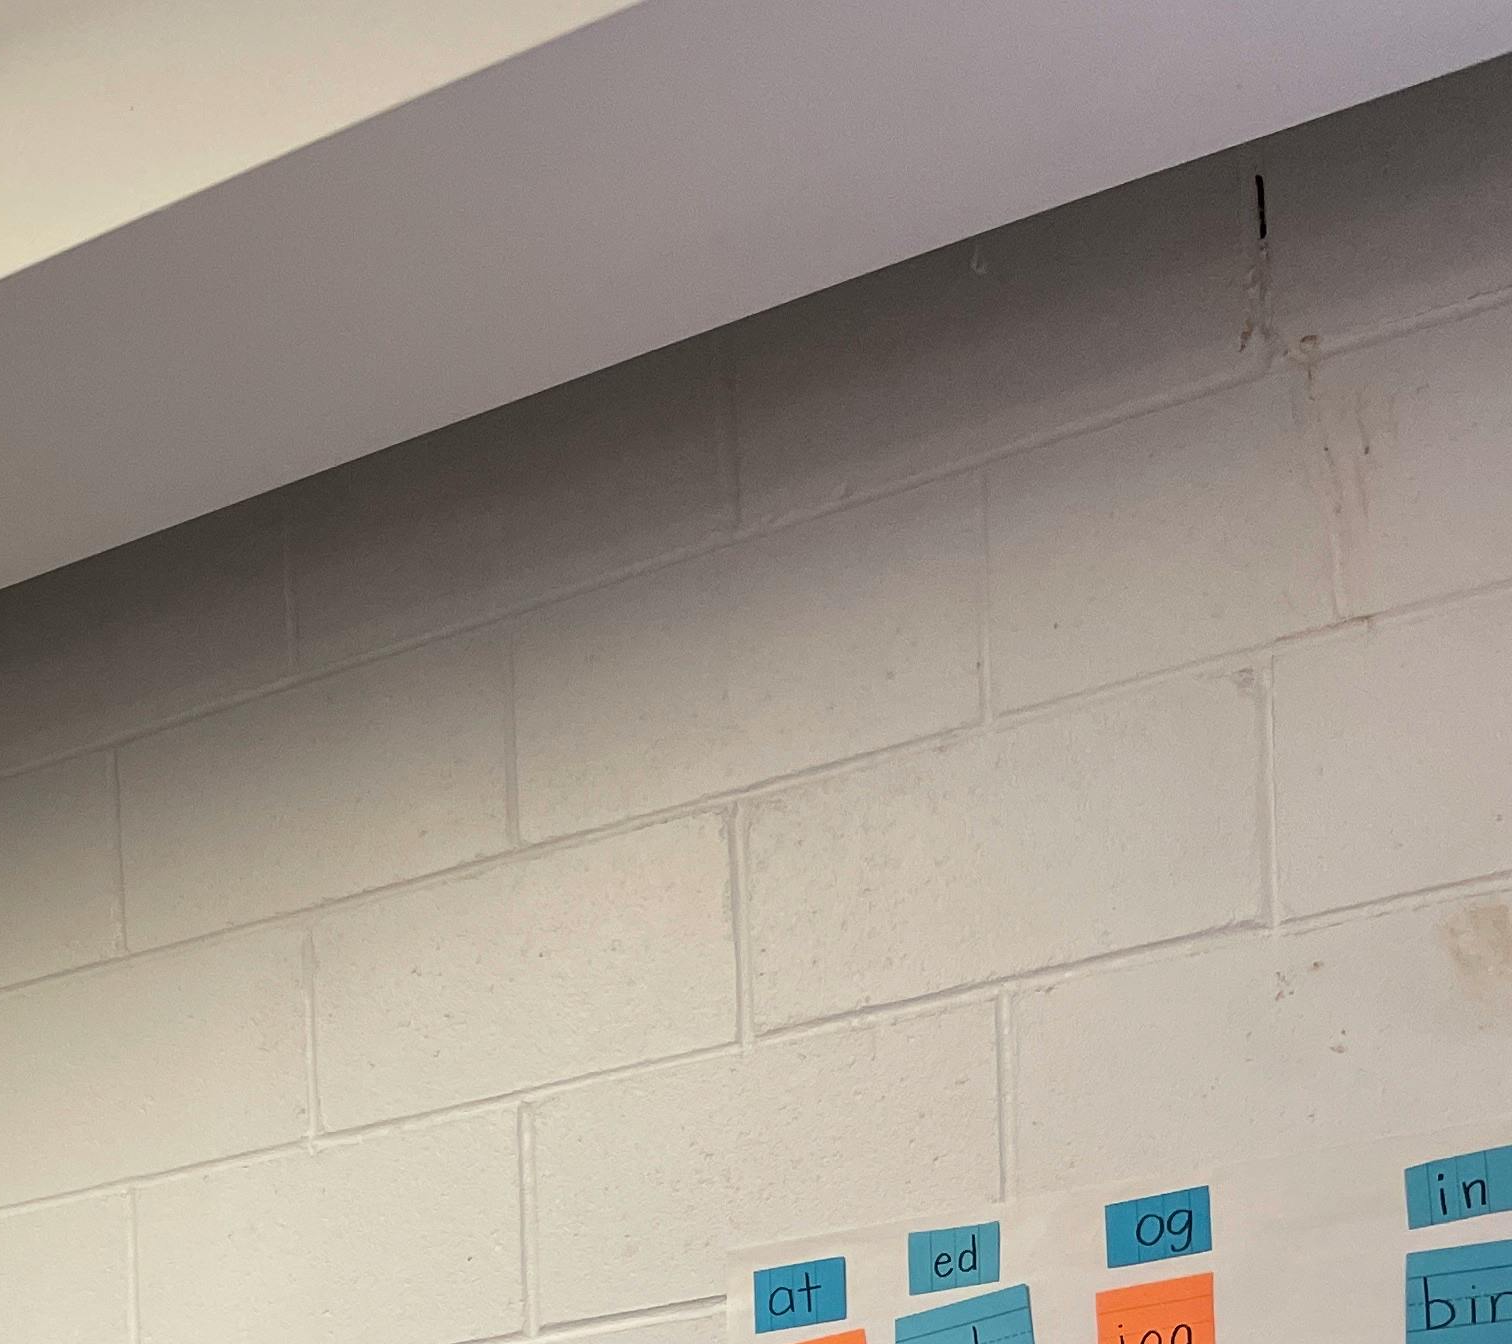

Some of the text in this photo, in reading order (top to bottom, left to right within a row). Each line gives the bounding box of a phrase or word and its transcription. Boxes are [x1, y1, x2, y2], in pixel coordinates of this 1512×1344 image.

[1437, 1172, 1487, 1216] in
[1135, 1208, 1193, 1253] og
[934, 1234, 978, 1278] ed
[768, 1272, 821, 1316] at
